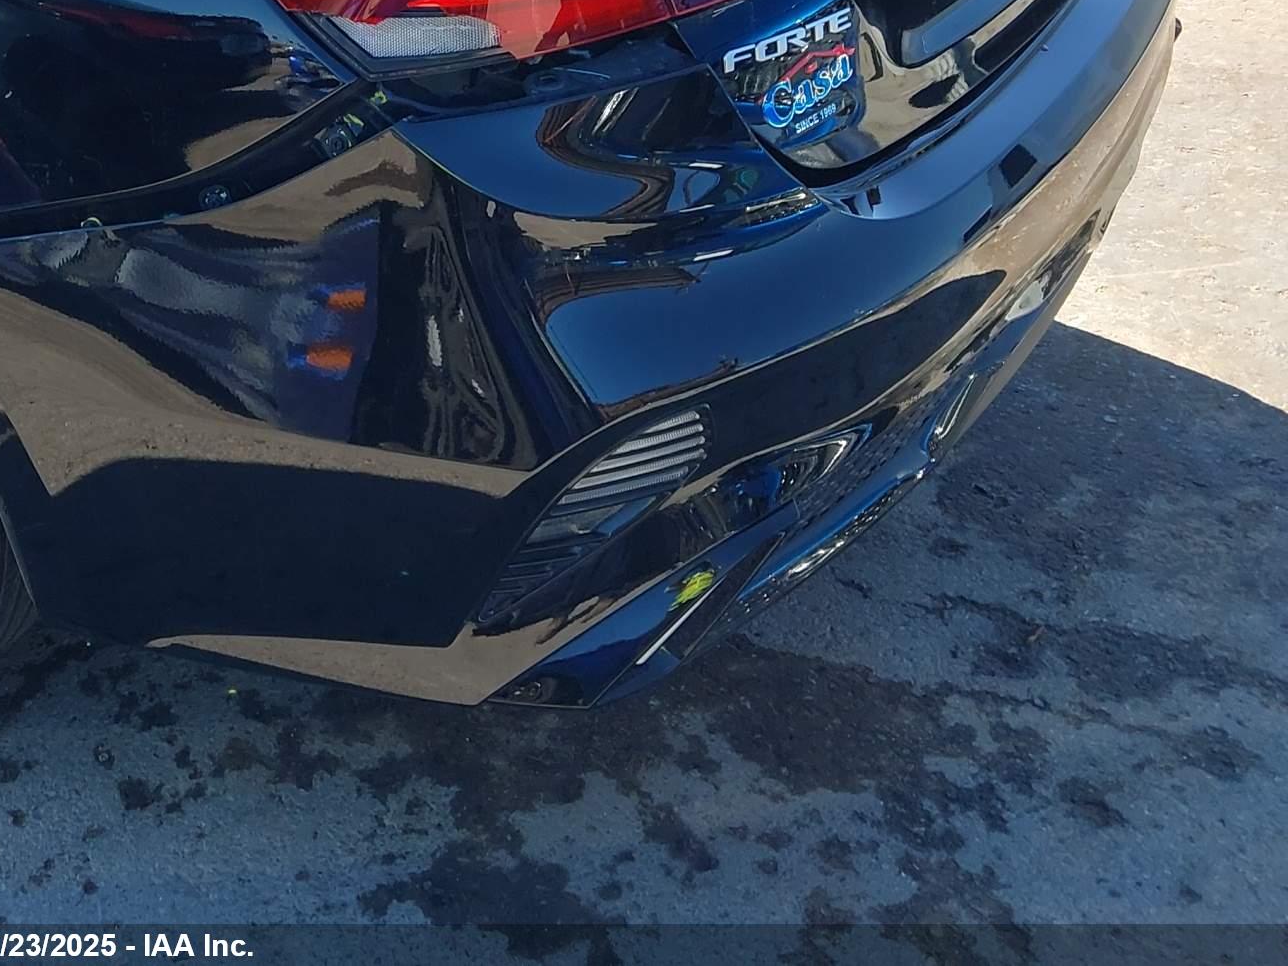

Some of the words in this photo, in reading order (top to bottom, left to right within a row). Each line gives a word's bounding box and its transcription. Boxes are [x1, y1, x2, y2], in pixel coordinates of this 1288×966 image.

[723, 8, 852, 74] FORTE
[763, 53, 853, 128] Casa
[795, 115, 820, 134] SINCE
[819, 103, 837, 121] 1969
